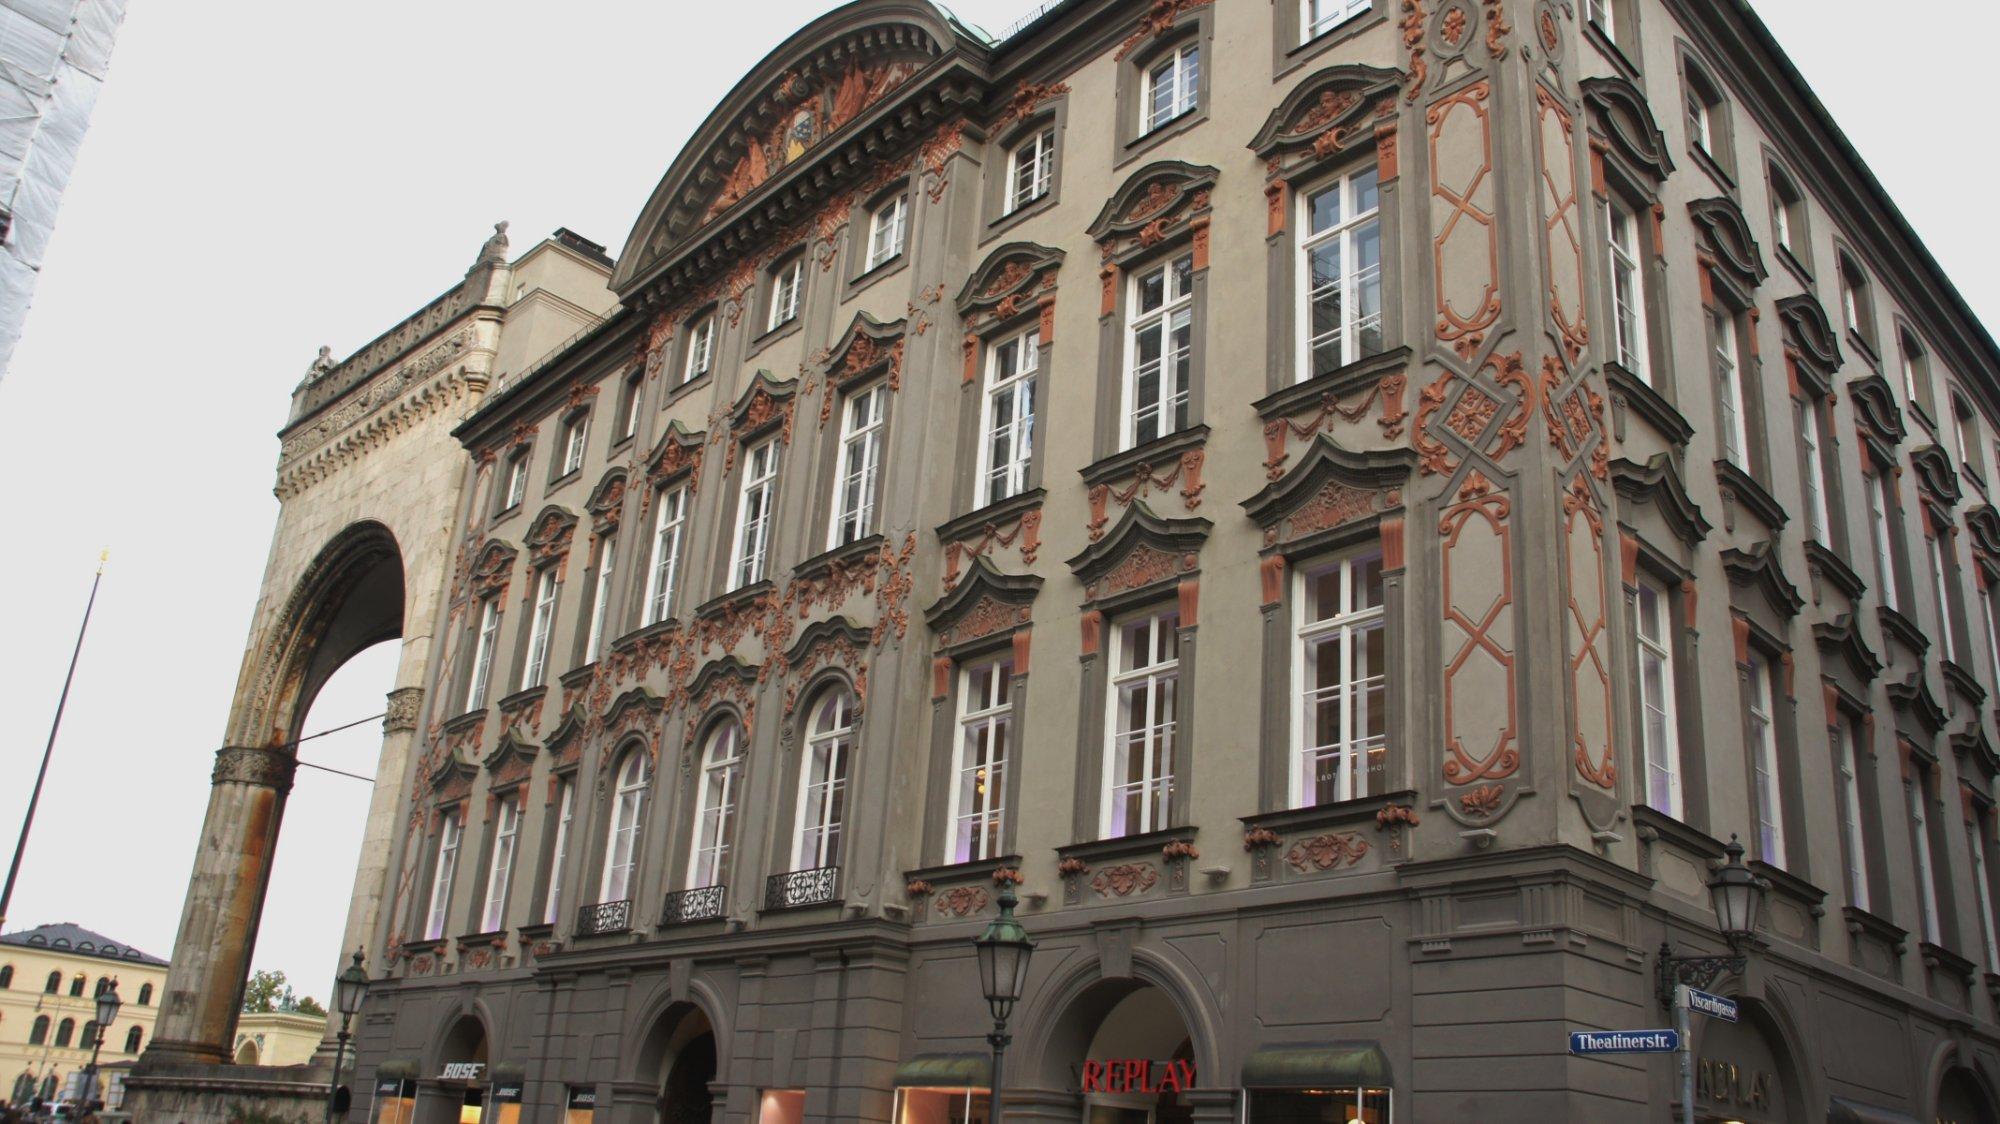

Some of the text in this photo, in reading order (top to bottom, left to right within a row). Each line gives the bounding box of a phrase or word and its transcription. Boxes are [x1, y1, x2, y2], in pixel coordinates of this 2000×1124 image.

[1689, 990, 1736, 1018] Viscardigasse
[1577, 1034, 1670, 1050] Theatinerstr.
[436, 1063, 486, 1079] BOSE
[1083, 1059, 1197, 1094] REPLAY
